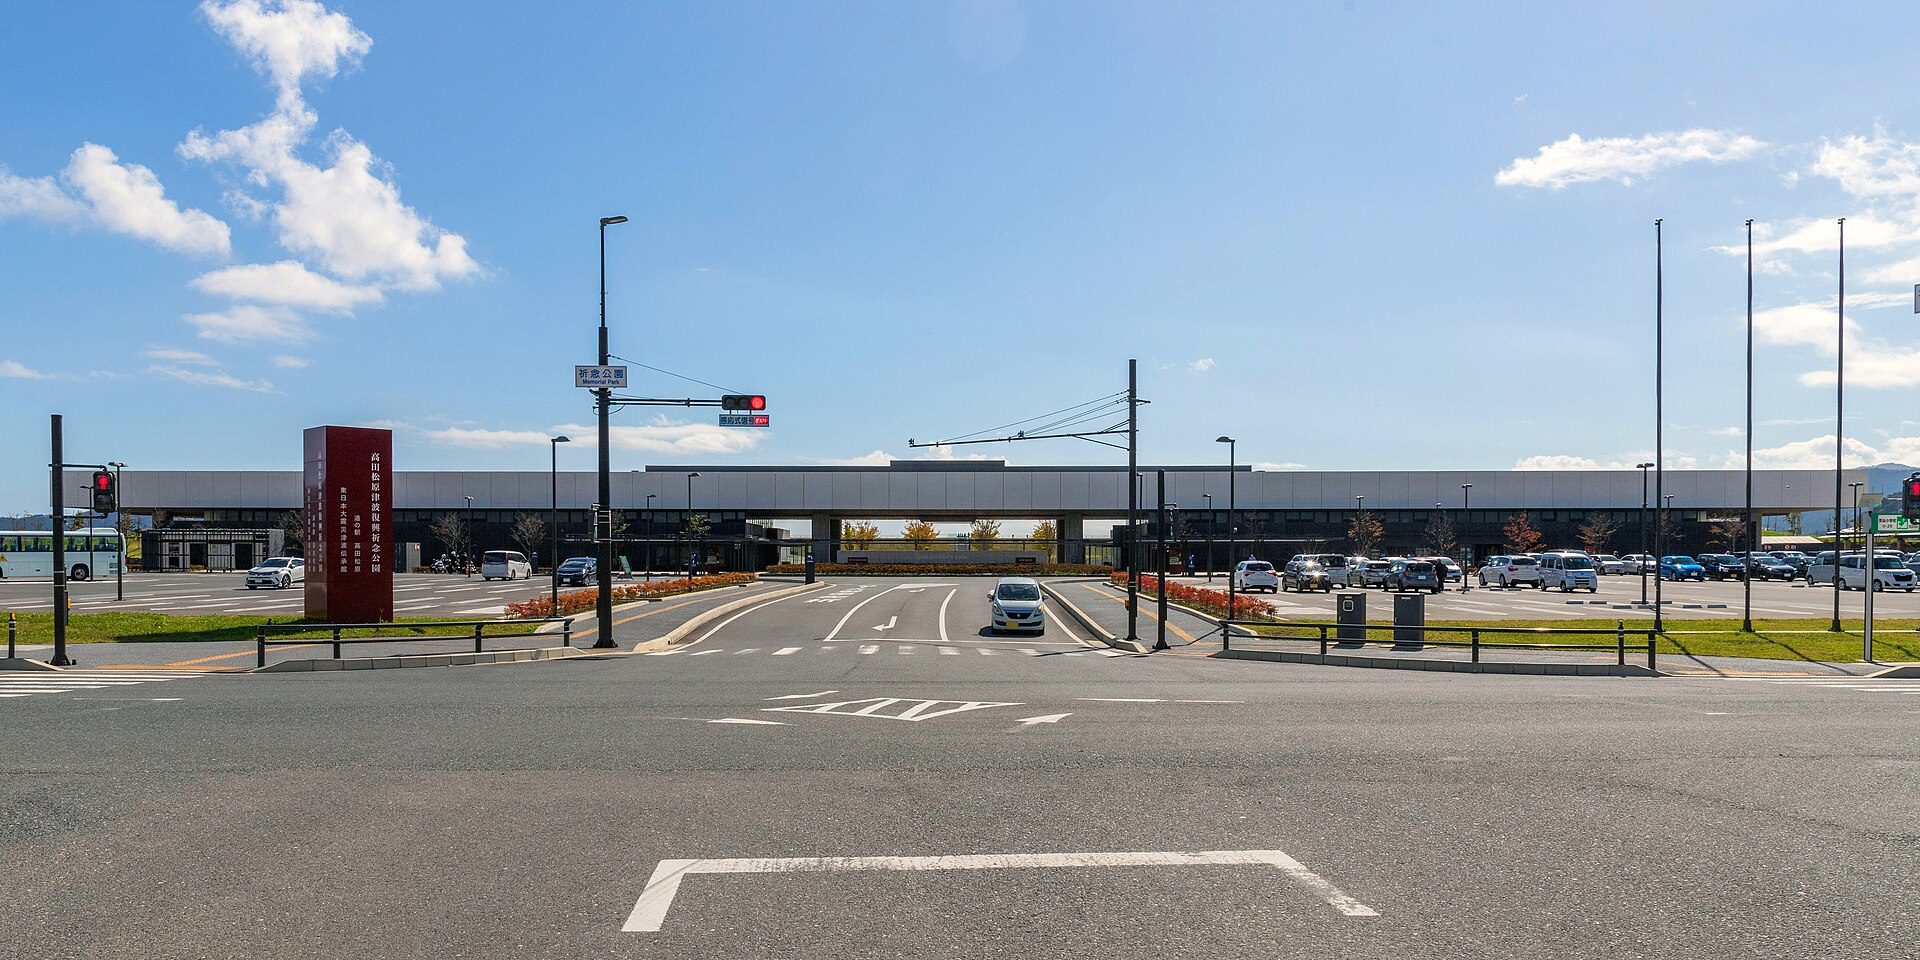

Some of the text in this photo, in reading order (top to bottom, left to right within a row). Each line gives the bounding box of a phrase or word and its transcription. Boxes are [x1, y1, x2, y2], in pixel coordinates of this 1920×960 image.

[579, 368, 624, 379] 祈念公園
[340, 487, 348, 573] 東日本大震災津波伝承館
[371, 452, 381, 573] 高田松原津波復興祈念公園
